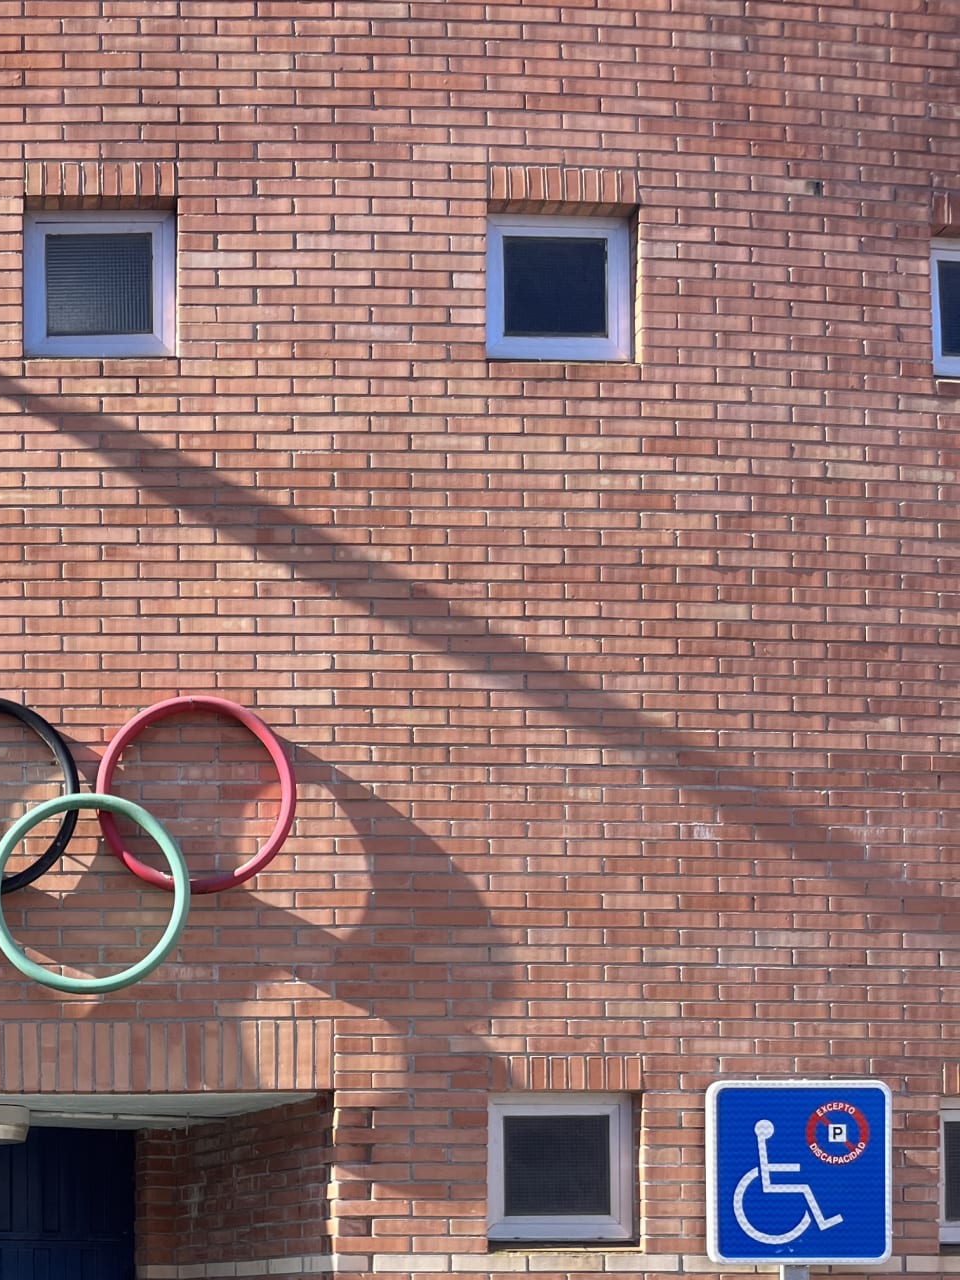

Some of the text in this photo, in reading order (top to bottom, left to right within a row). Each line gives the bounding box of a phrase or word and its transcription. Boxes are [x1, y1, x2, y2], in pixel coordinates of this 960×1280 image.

[816, 1102, 856, 1117] EXCEPTO
[833, 1127, 843, 1140] P
[809, 1142, 866, 1165] DISCAPACIDAD
